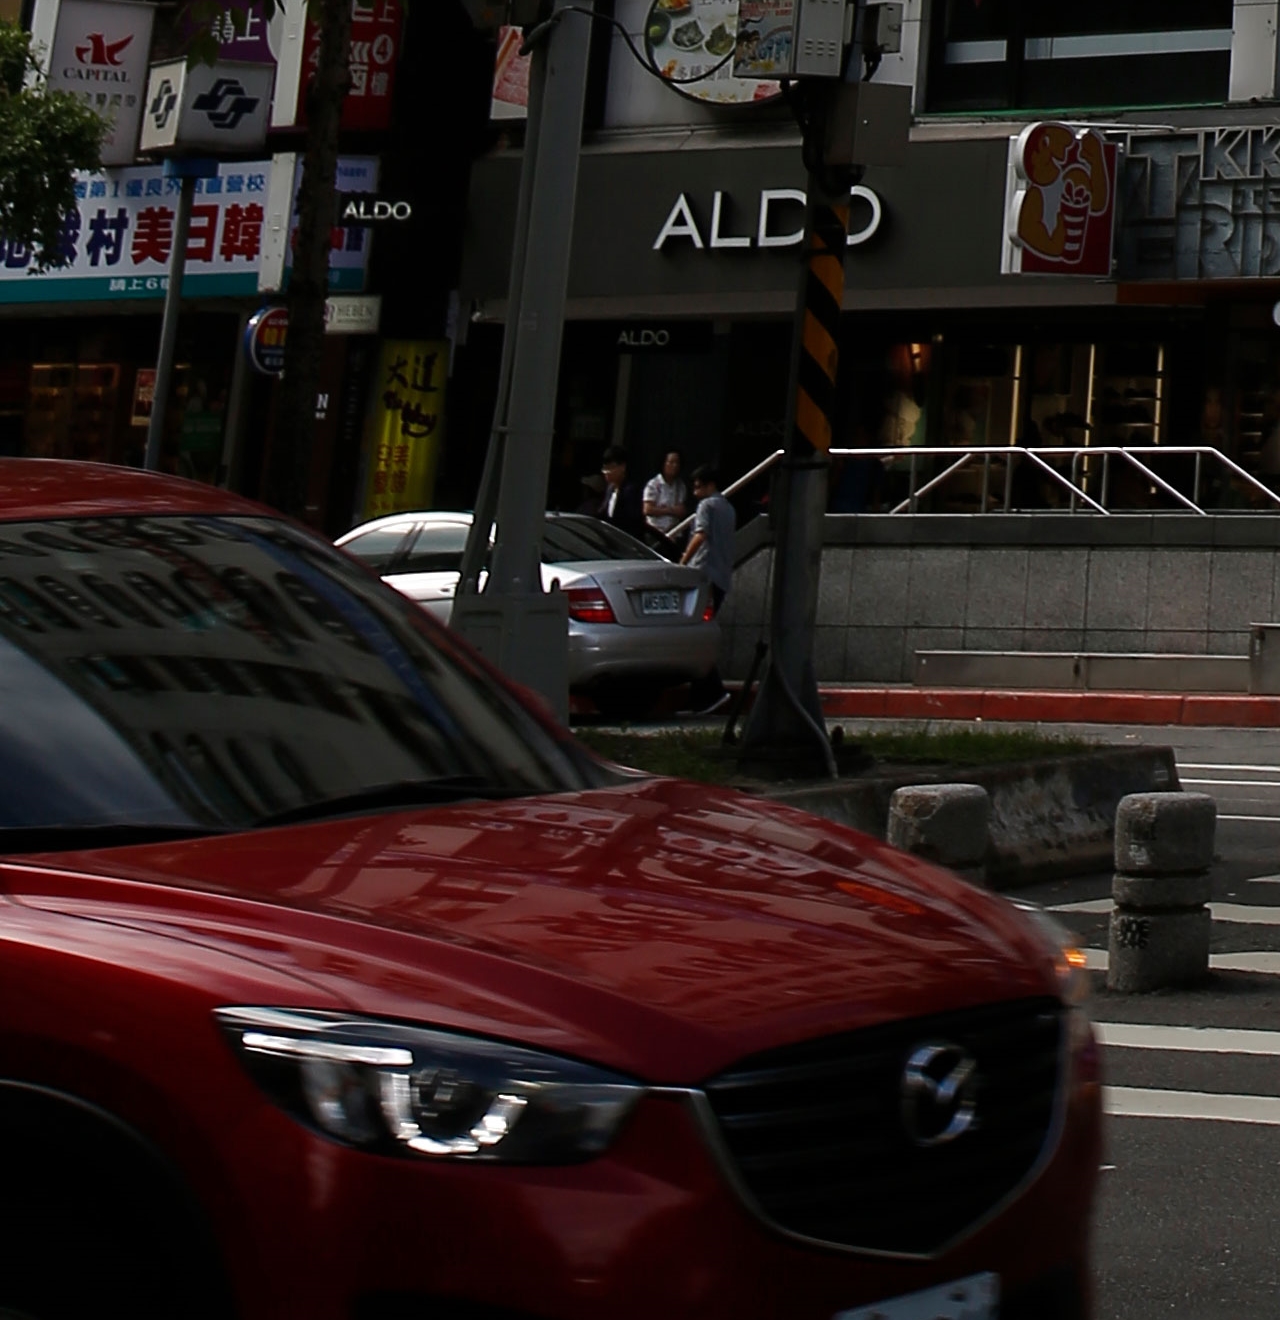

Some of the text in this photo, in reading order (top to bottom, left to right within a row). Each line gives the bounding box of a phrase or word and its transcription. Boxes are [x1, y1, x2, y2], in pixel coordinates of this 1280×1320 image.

[63, 66, 128, 83] CAPITAL
[343, 200, 412, 221] ALDO
[652, 184, 884, 251] ALDO
[616, 329, 671, 347] ALDO
